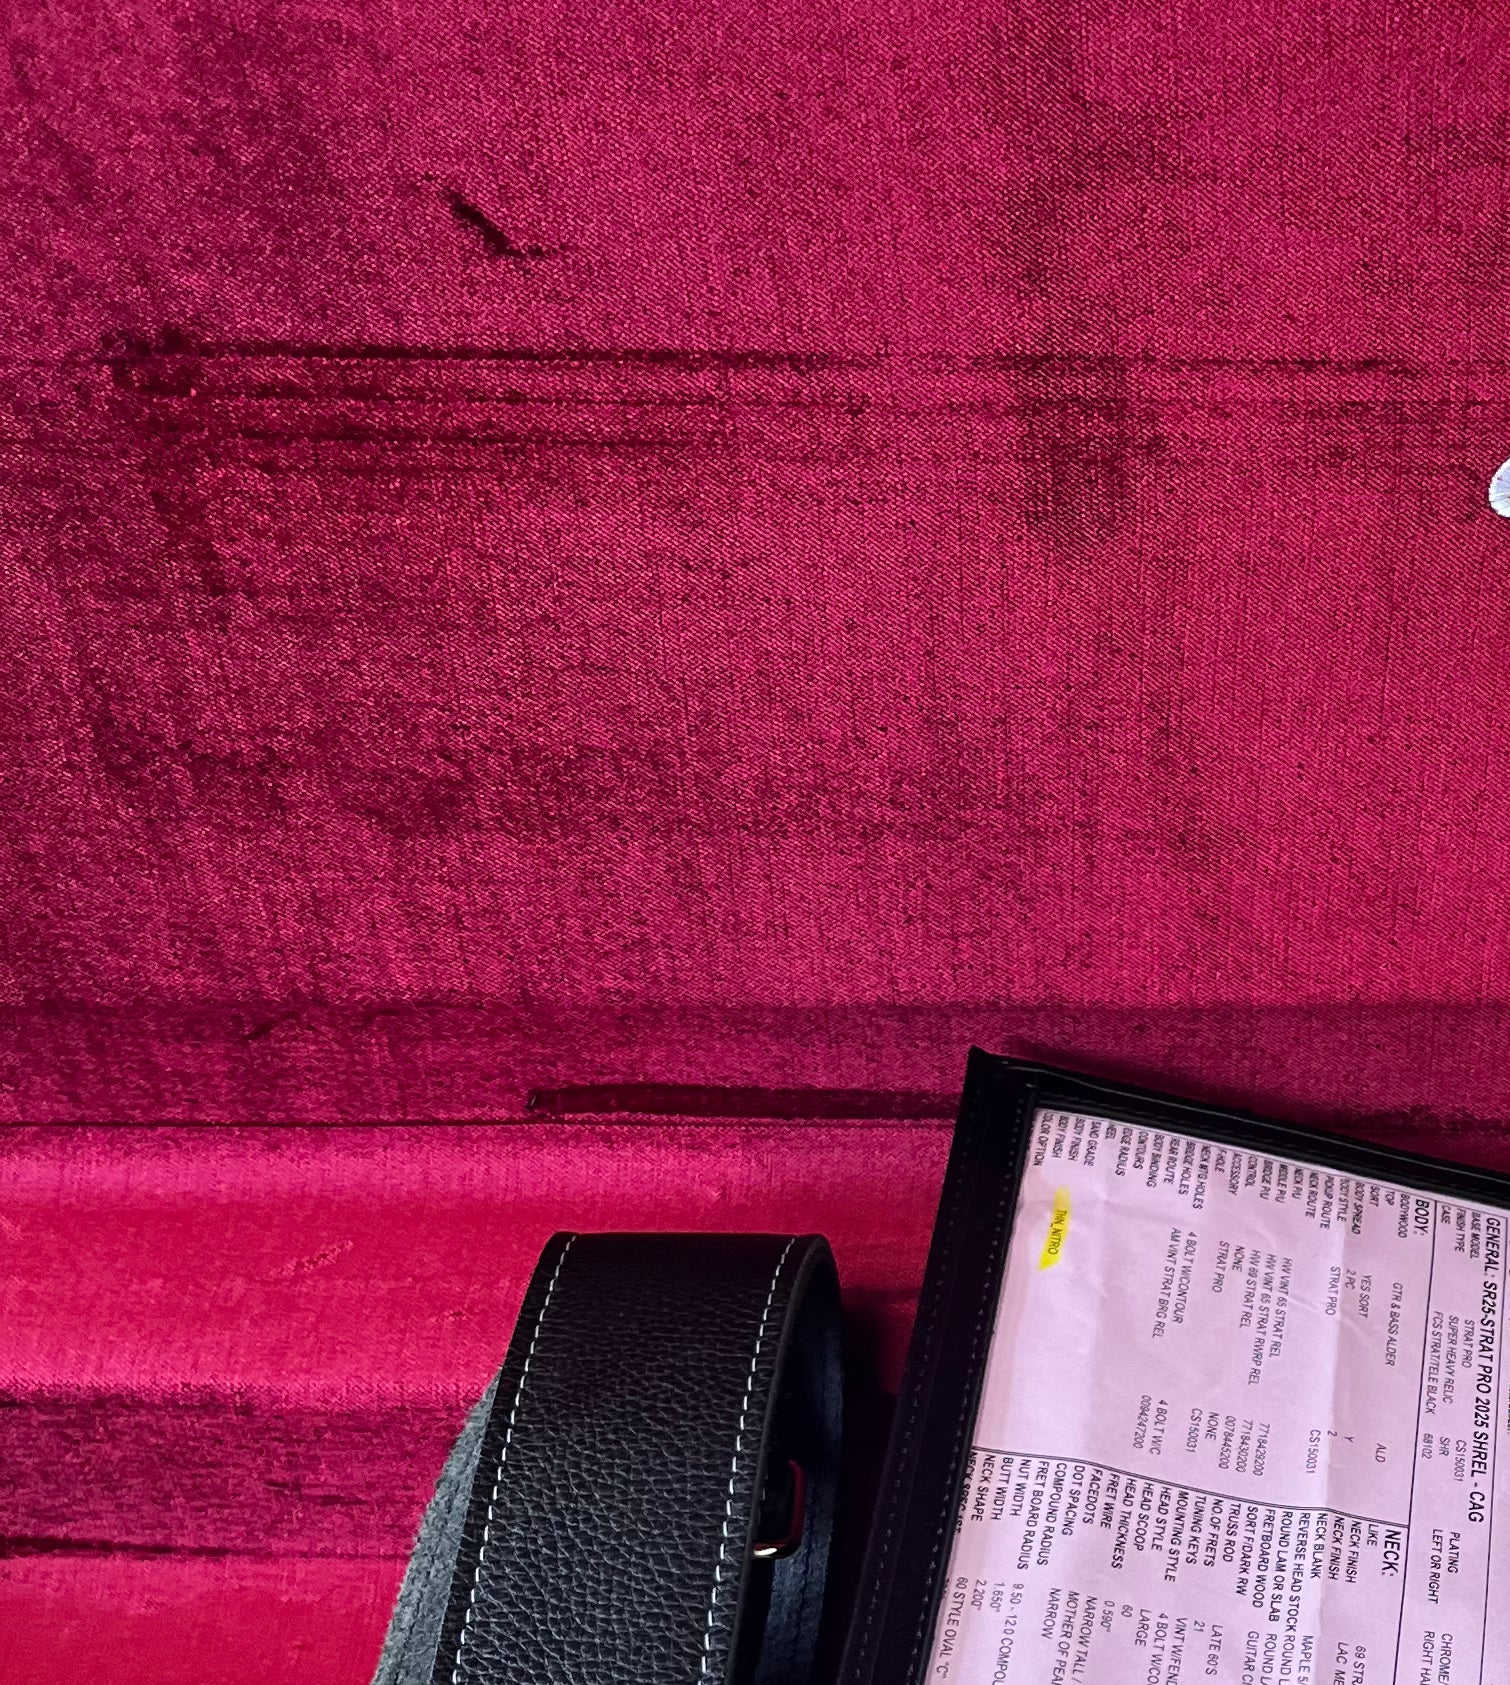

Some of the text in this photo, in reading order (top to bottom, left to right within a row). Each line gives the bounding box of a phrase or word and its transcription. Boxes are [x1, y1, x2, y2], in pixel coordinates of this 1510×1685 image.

[1413, 1197, 1429, 1235] BODY:
[1483, 1216, 1502, 1277] GENERAL:
[1478, 1280, 1497, 1362] SR25-STRAT
[1442, 1314, 1458, 1403] SUPER HEAVY RELIC
[1475, 1363, 1492, 1393] PRO
[1473, 1396, 1490, 1428] 2025
[1470, 1430, 1488, 1477] SHREL
[1467, 1491, 1484, 1522] CAG
[1381, 1528, 1401, 1576] NECK:
[1447, 1531, 1460, 1573] PLATING
[955, 1576, 968, 1589] 60
[946, 1591, 965, 1626] STYLE
[1059, 1590, 1079, 1638] MOTHER
[939, 1628, 957, 1657] OVAL
[1057, 1640, 1070, 1657] OF
